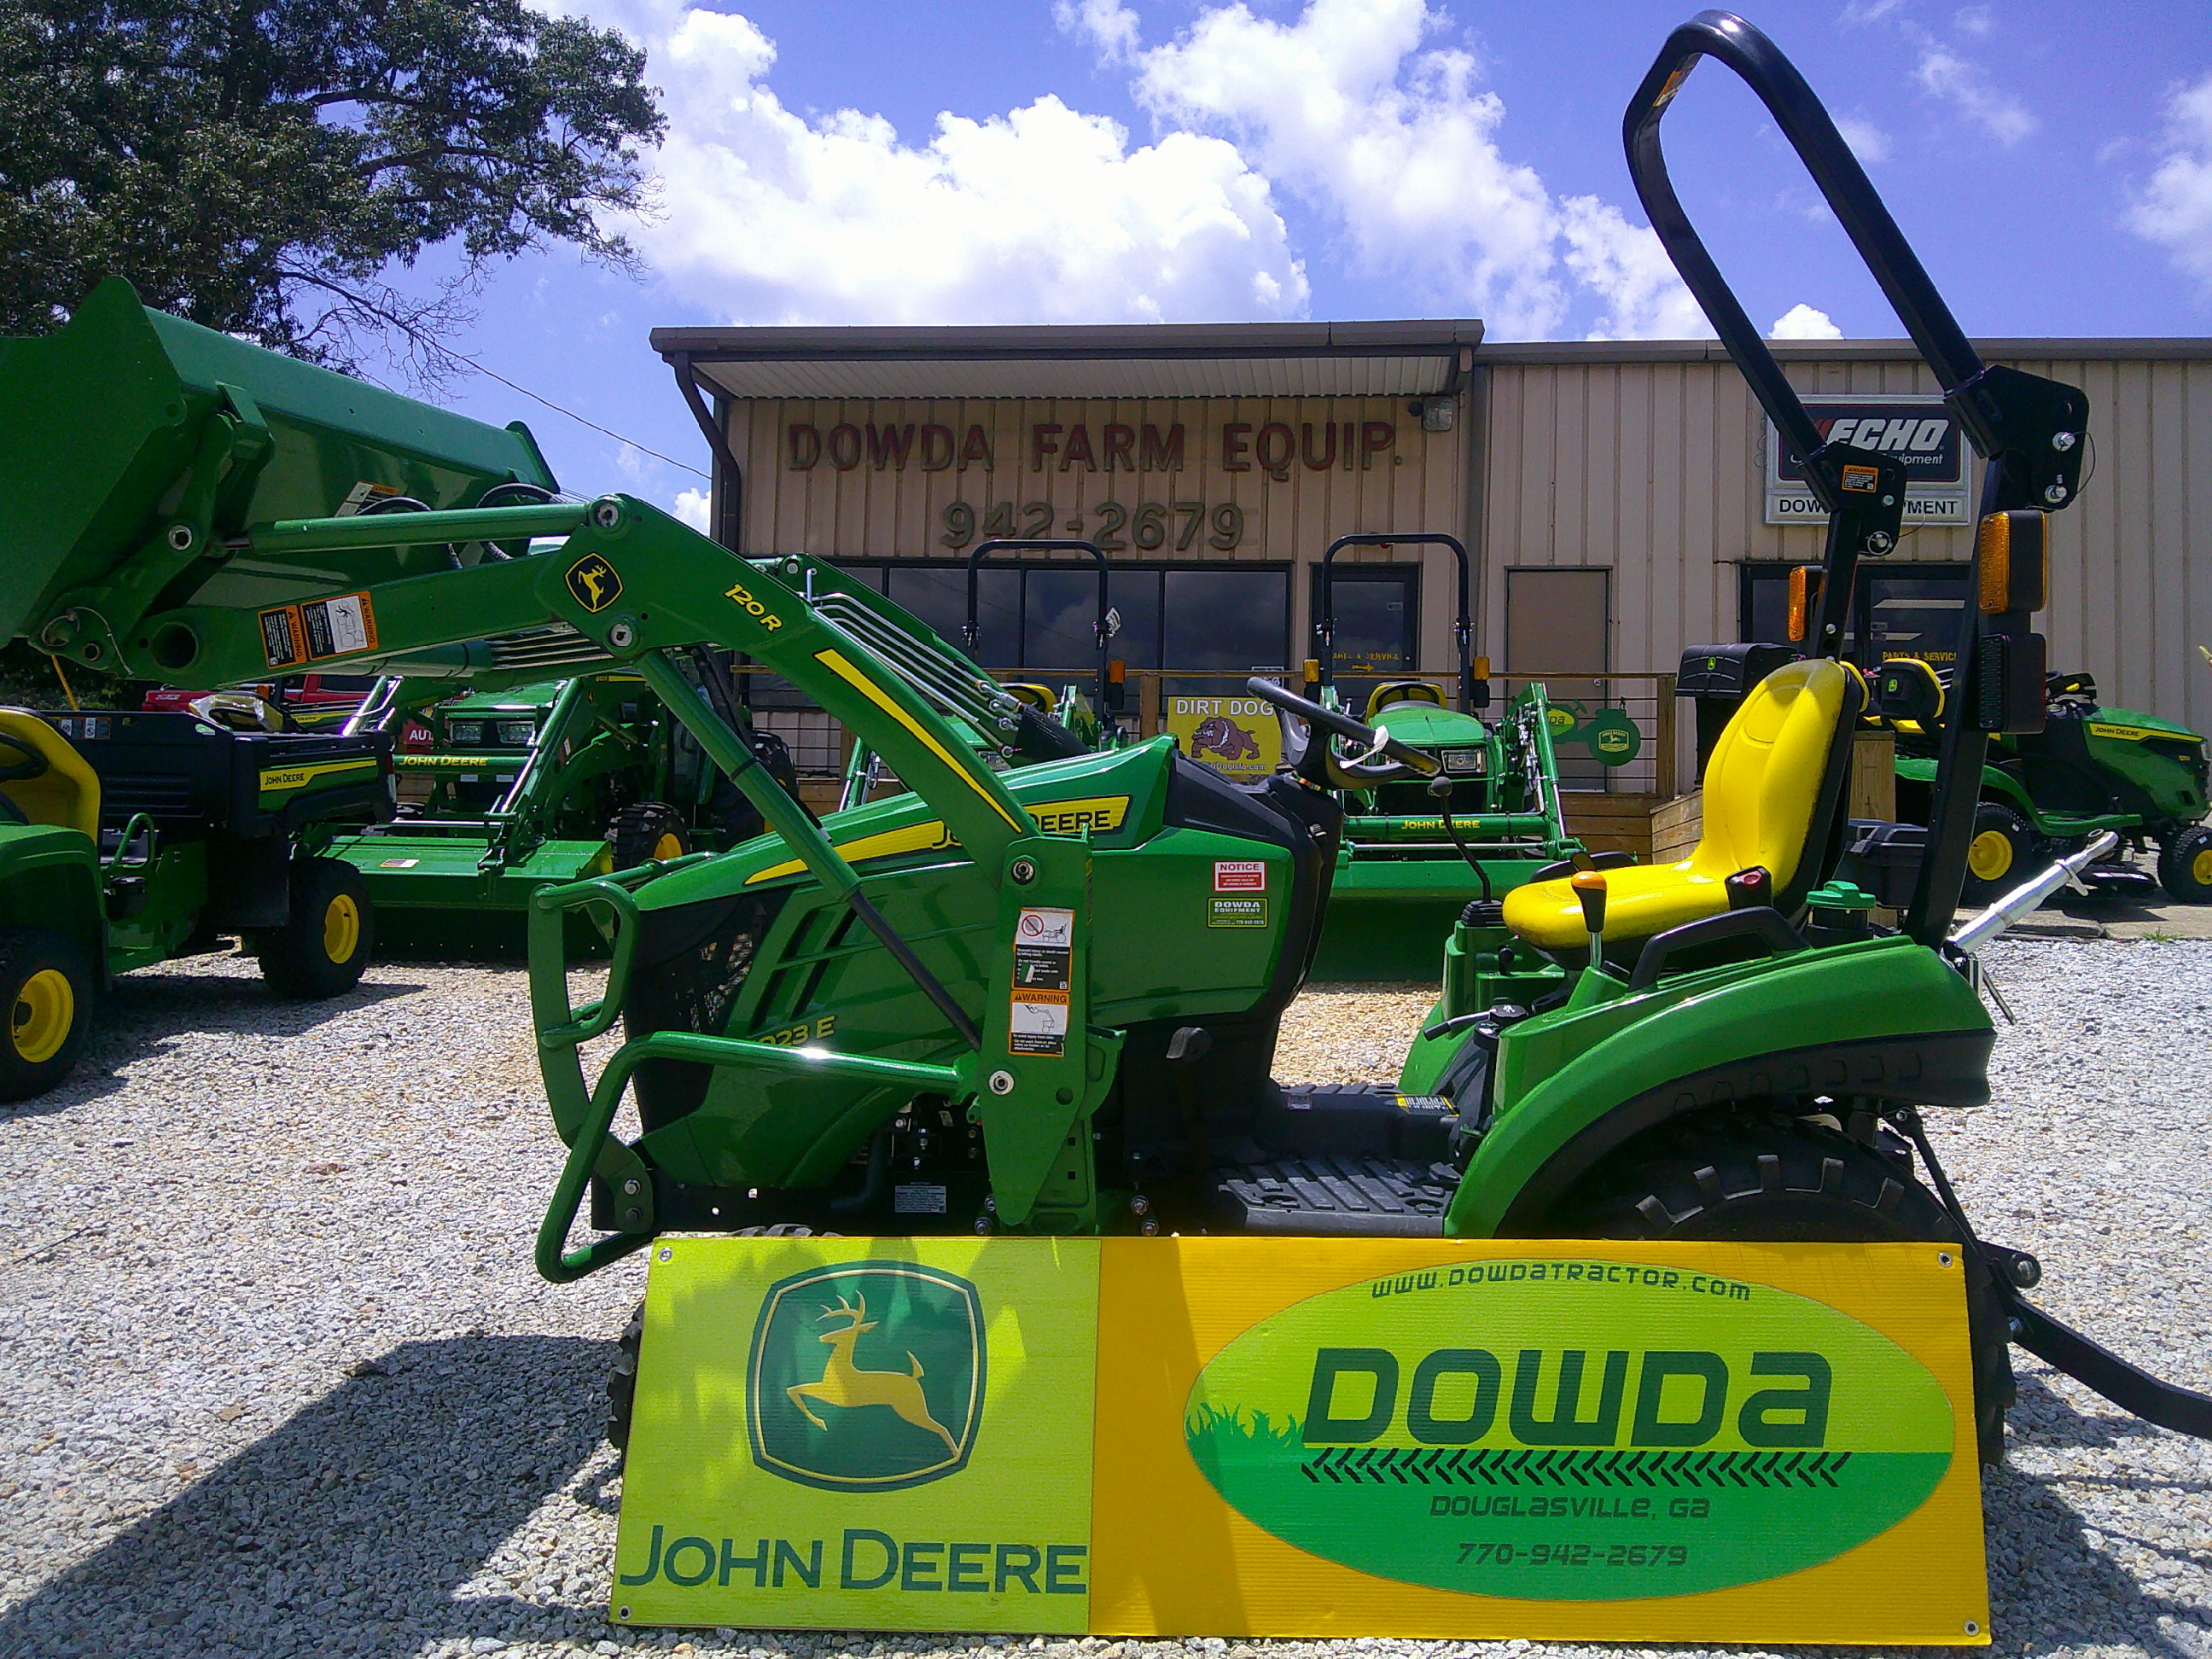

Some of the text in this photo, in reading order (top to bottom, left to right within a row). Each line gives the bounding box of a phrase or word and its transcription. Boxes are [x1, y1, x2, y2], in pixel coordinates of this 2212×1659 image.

[1826, 419, 1950, 451] ECHO
[787, 422, 1404, 482] DOWDA FARM EQUIP.
[1779, 499, 1821, 512] DOW
[940, 500, 1244, 551] 942-2679
[725, 584, 783, 632] 120 R
[1177, 699, 1274, 716] DIRT DOG
[2116, 728, 2140, 737] DEERE
[399, 756, 489, 766] JOHN DEERE
[265, 772, 305, 786] JOHN DEERE
[1401, 820, 1435, 830] JOHN
[1022, 993, 1067, 1004] WARNING
[817, 1015, 835, 1039] E
[620, 1525, 1089, 1595] JOHN DEERE
[1455, 1542, 1688, 1567] 770-942-2679
